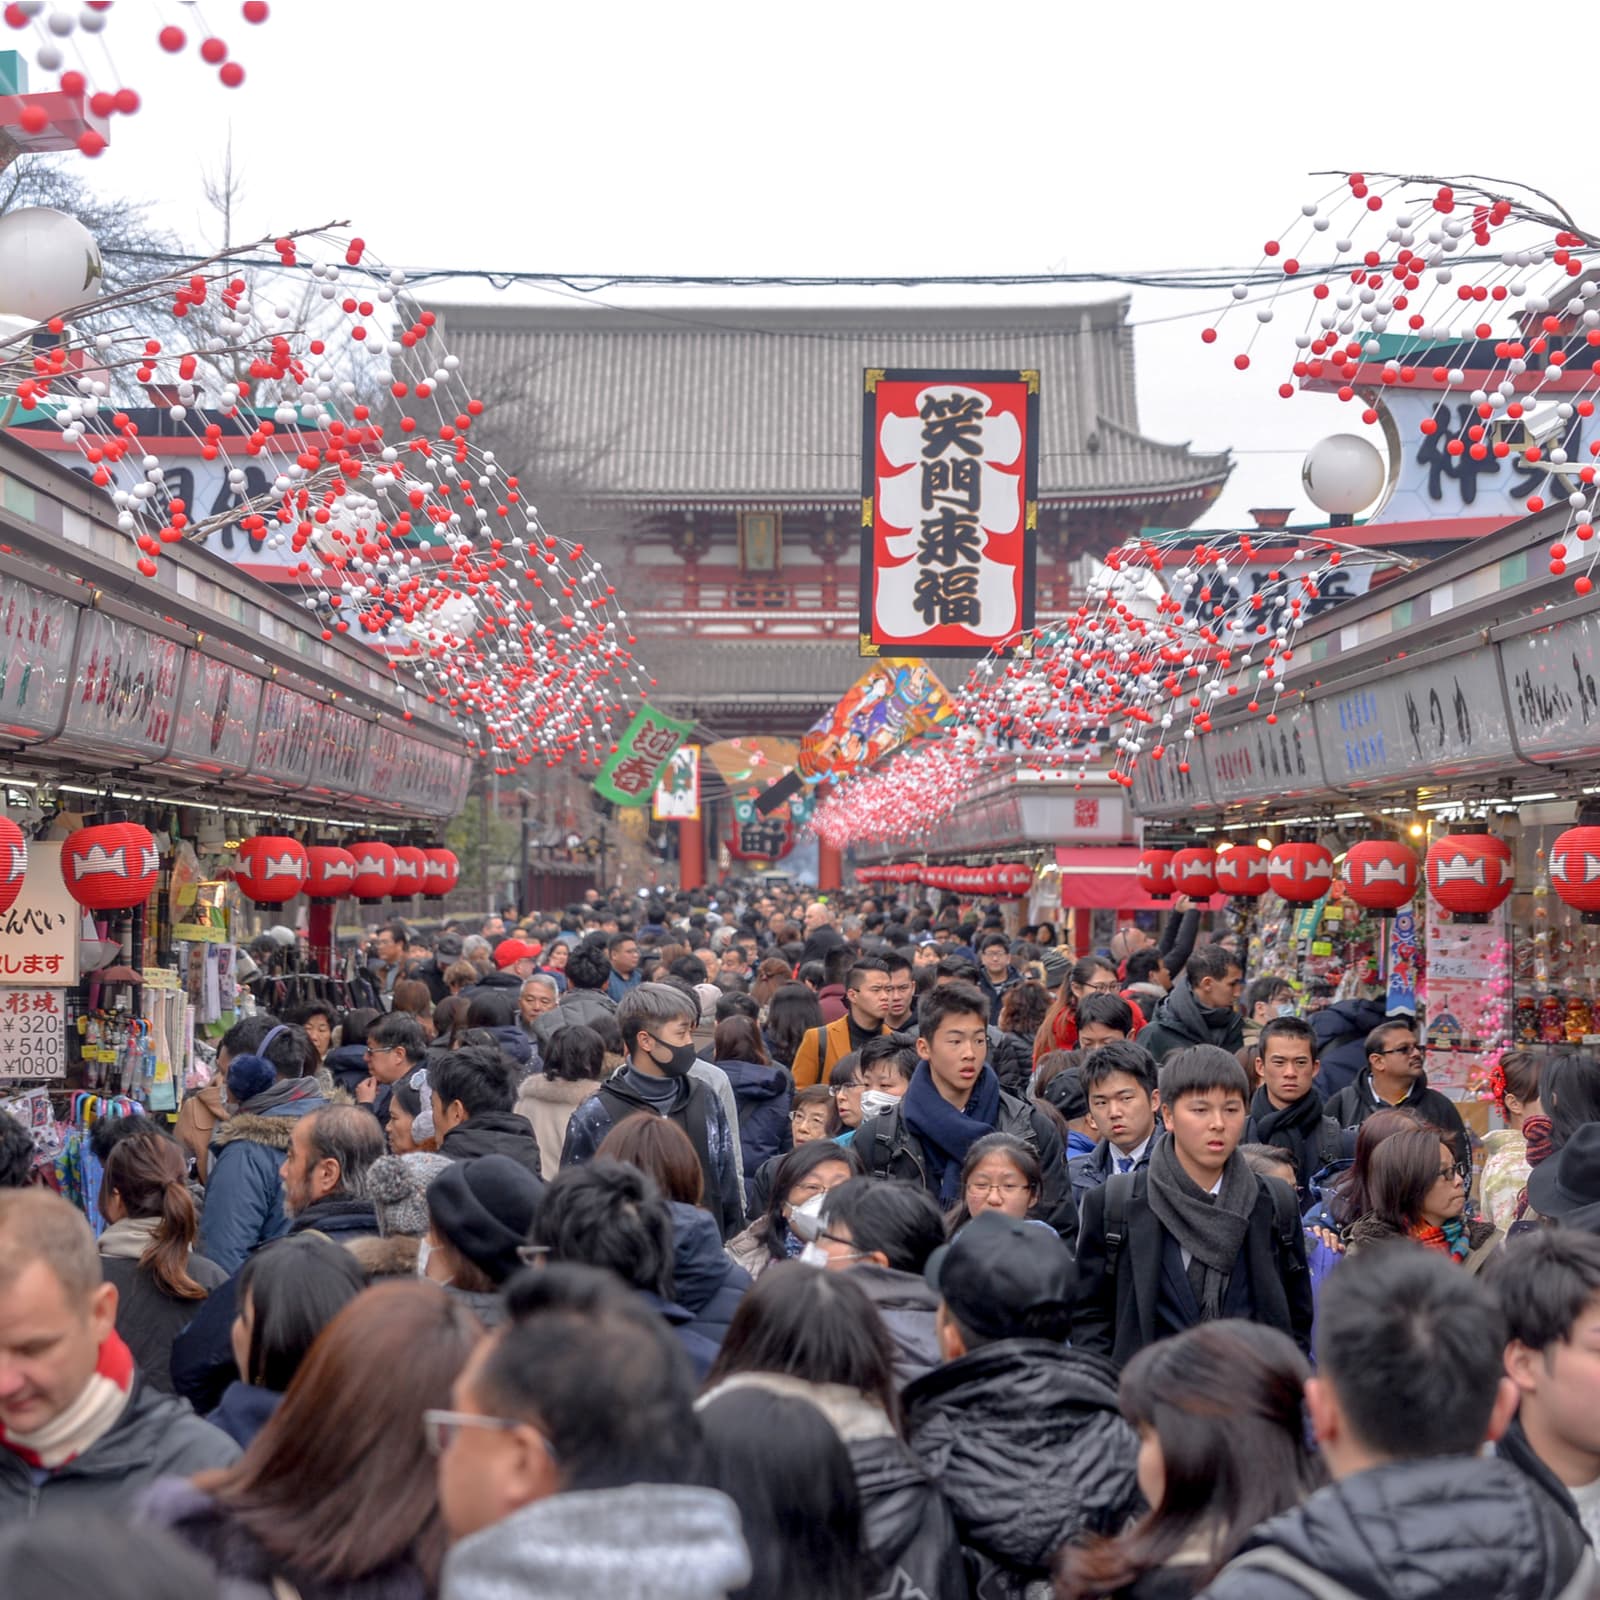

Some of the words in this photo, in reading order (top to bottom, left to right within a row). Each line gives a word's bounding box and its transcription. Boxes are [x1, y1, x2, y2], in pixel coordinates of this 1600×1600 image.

[914, 393, 984, 627] 笑門来福
[612, 719, 680, 796] 迎春
[0, 954, 64, 974] します
[0, 992, 59, 1015] 形焼
[3, 1015, 57, 1033] ¥320
[3, 1037, 57, 1055] ¥540
[4, 1057, 57, 1076] ¥1080
